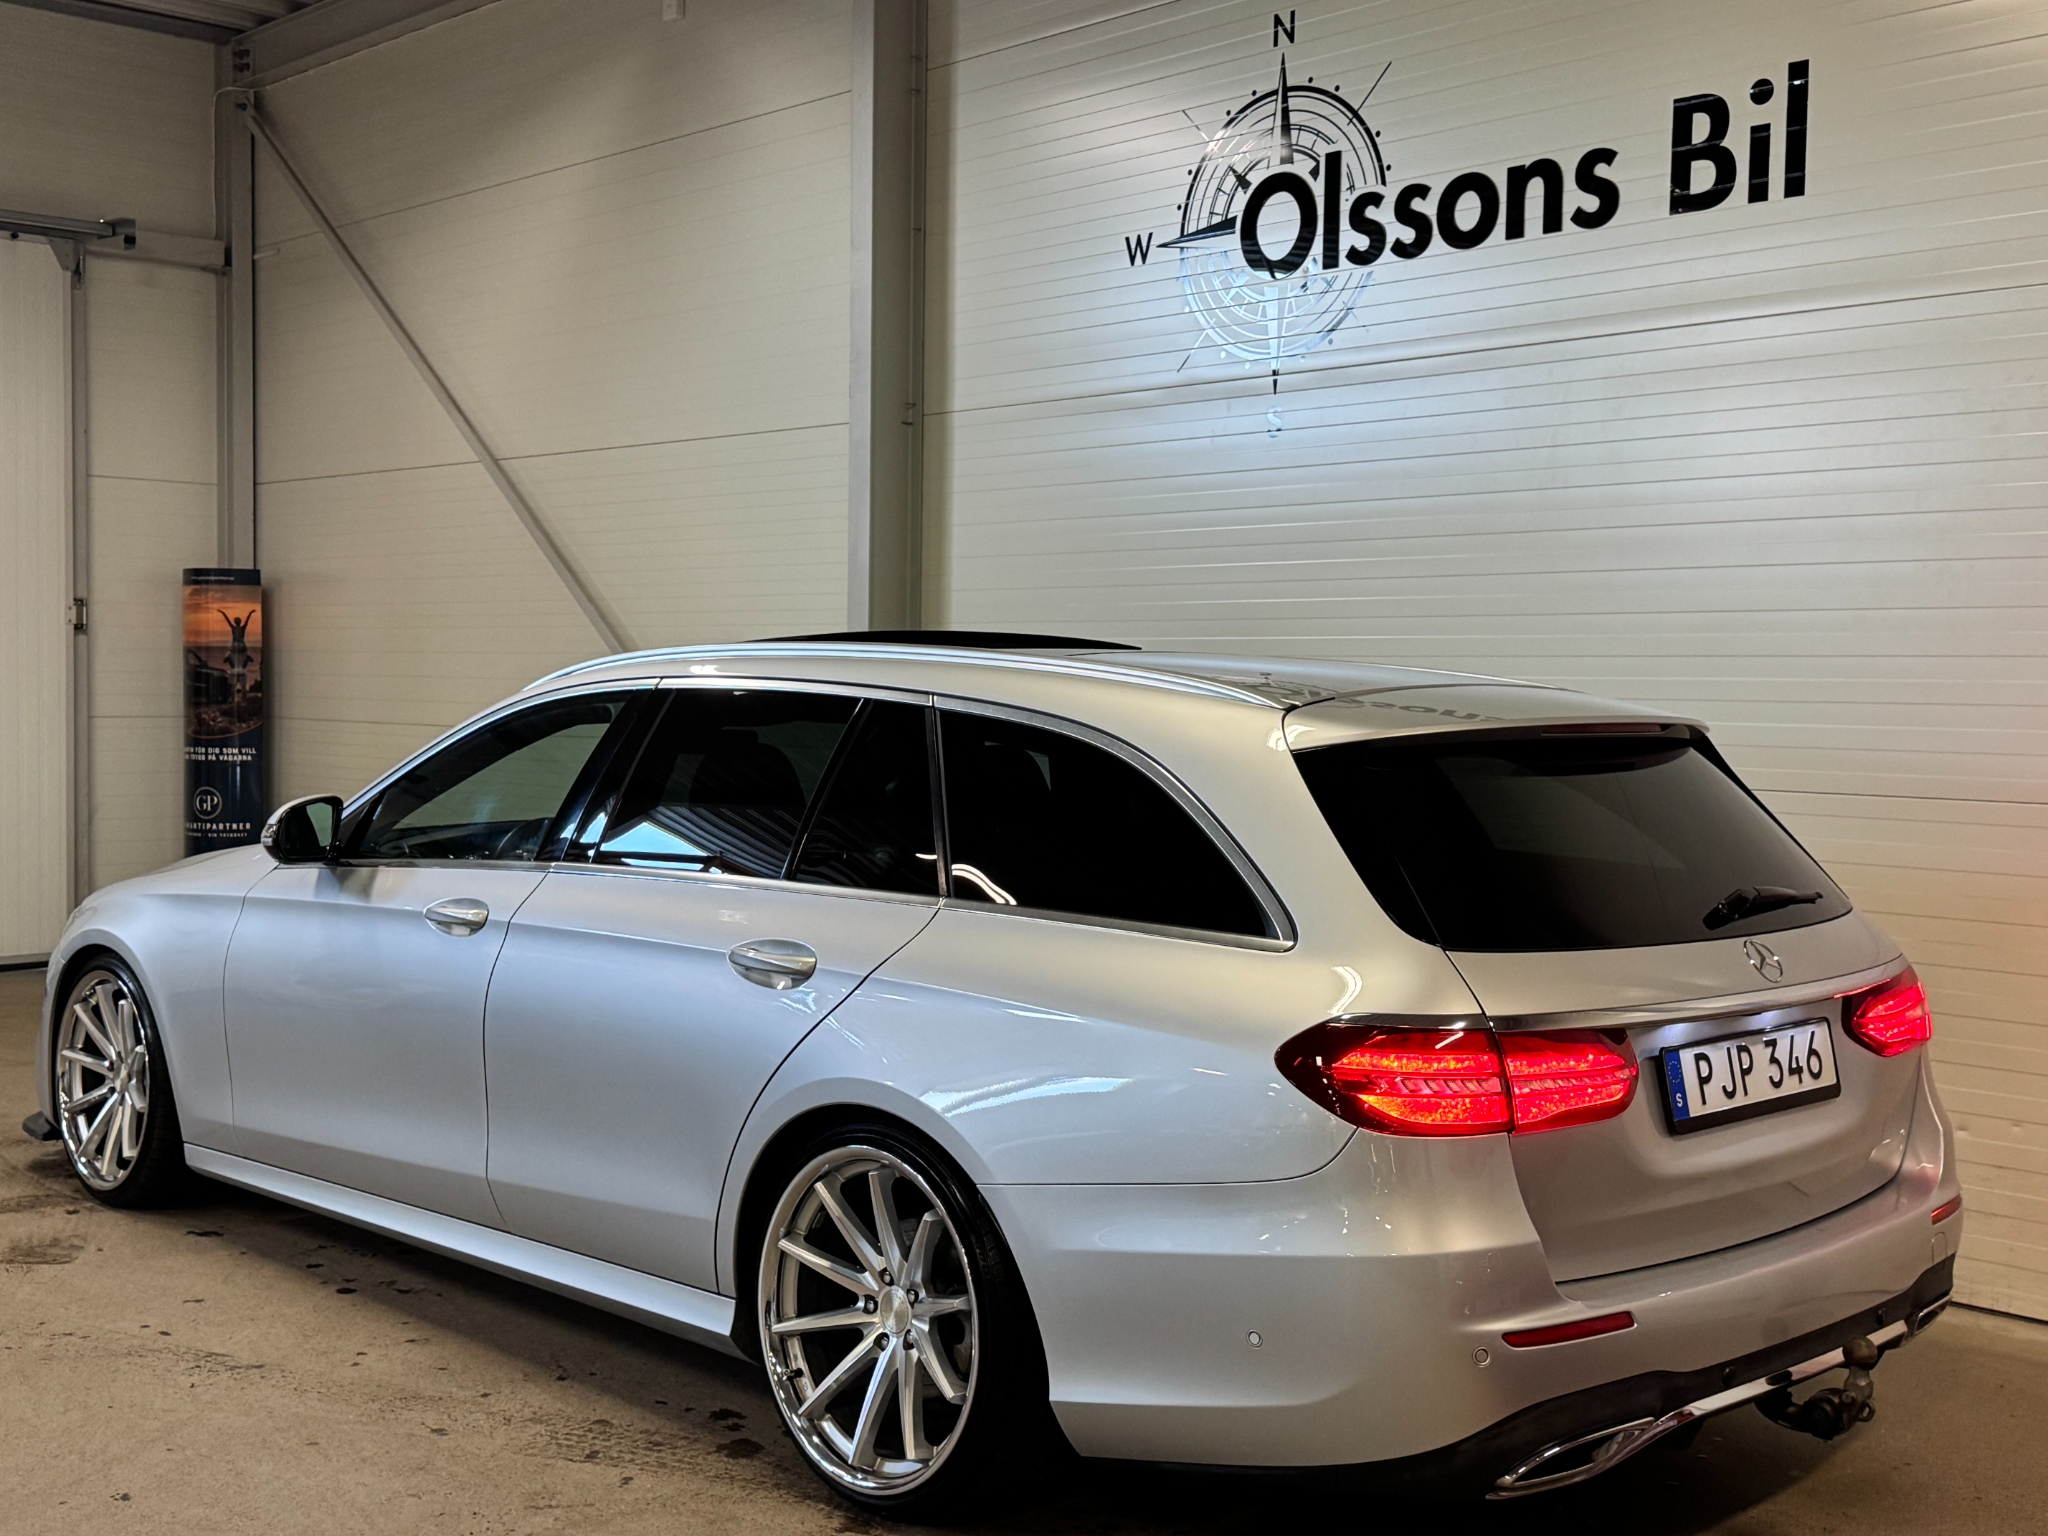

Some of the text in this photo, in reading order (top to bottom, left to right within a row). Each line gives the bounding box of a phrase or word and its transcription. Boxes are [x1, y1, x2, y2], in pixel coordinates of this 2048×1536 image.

[1272, 10, 1297, 48] N
[1239, 58, 1810, 281] Olssons Bil
[1124, 231, 1153, 267] W
[1265, 406, 1283, 439] S
[222, 747, 239, 755] SOM
[196, 795, 218, 811] GP
[1694, 1030, 1823, 1106] PJP 346
[1675, 1093, 1683, 1108] S
